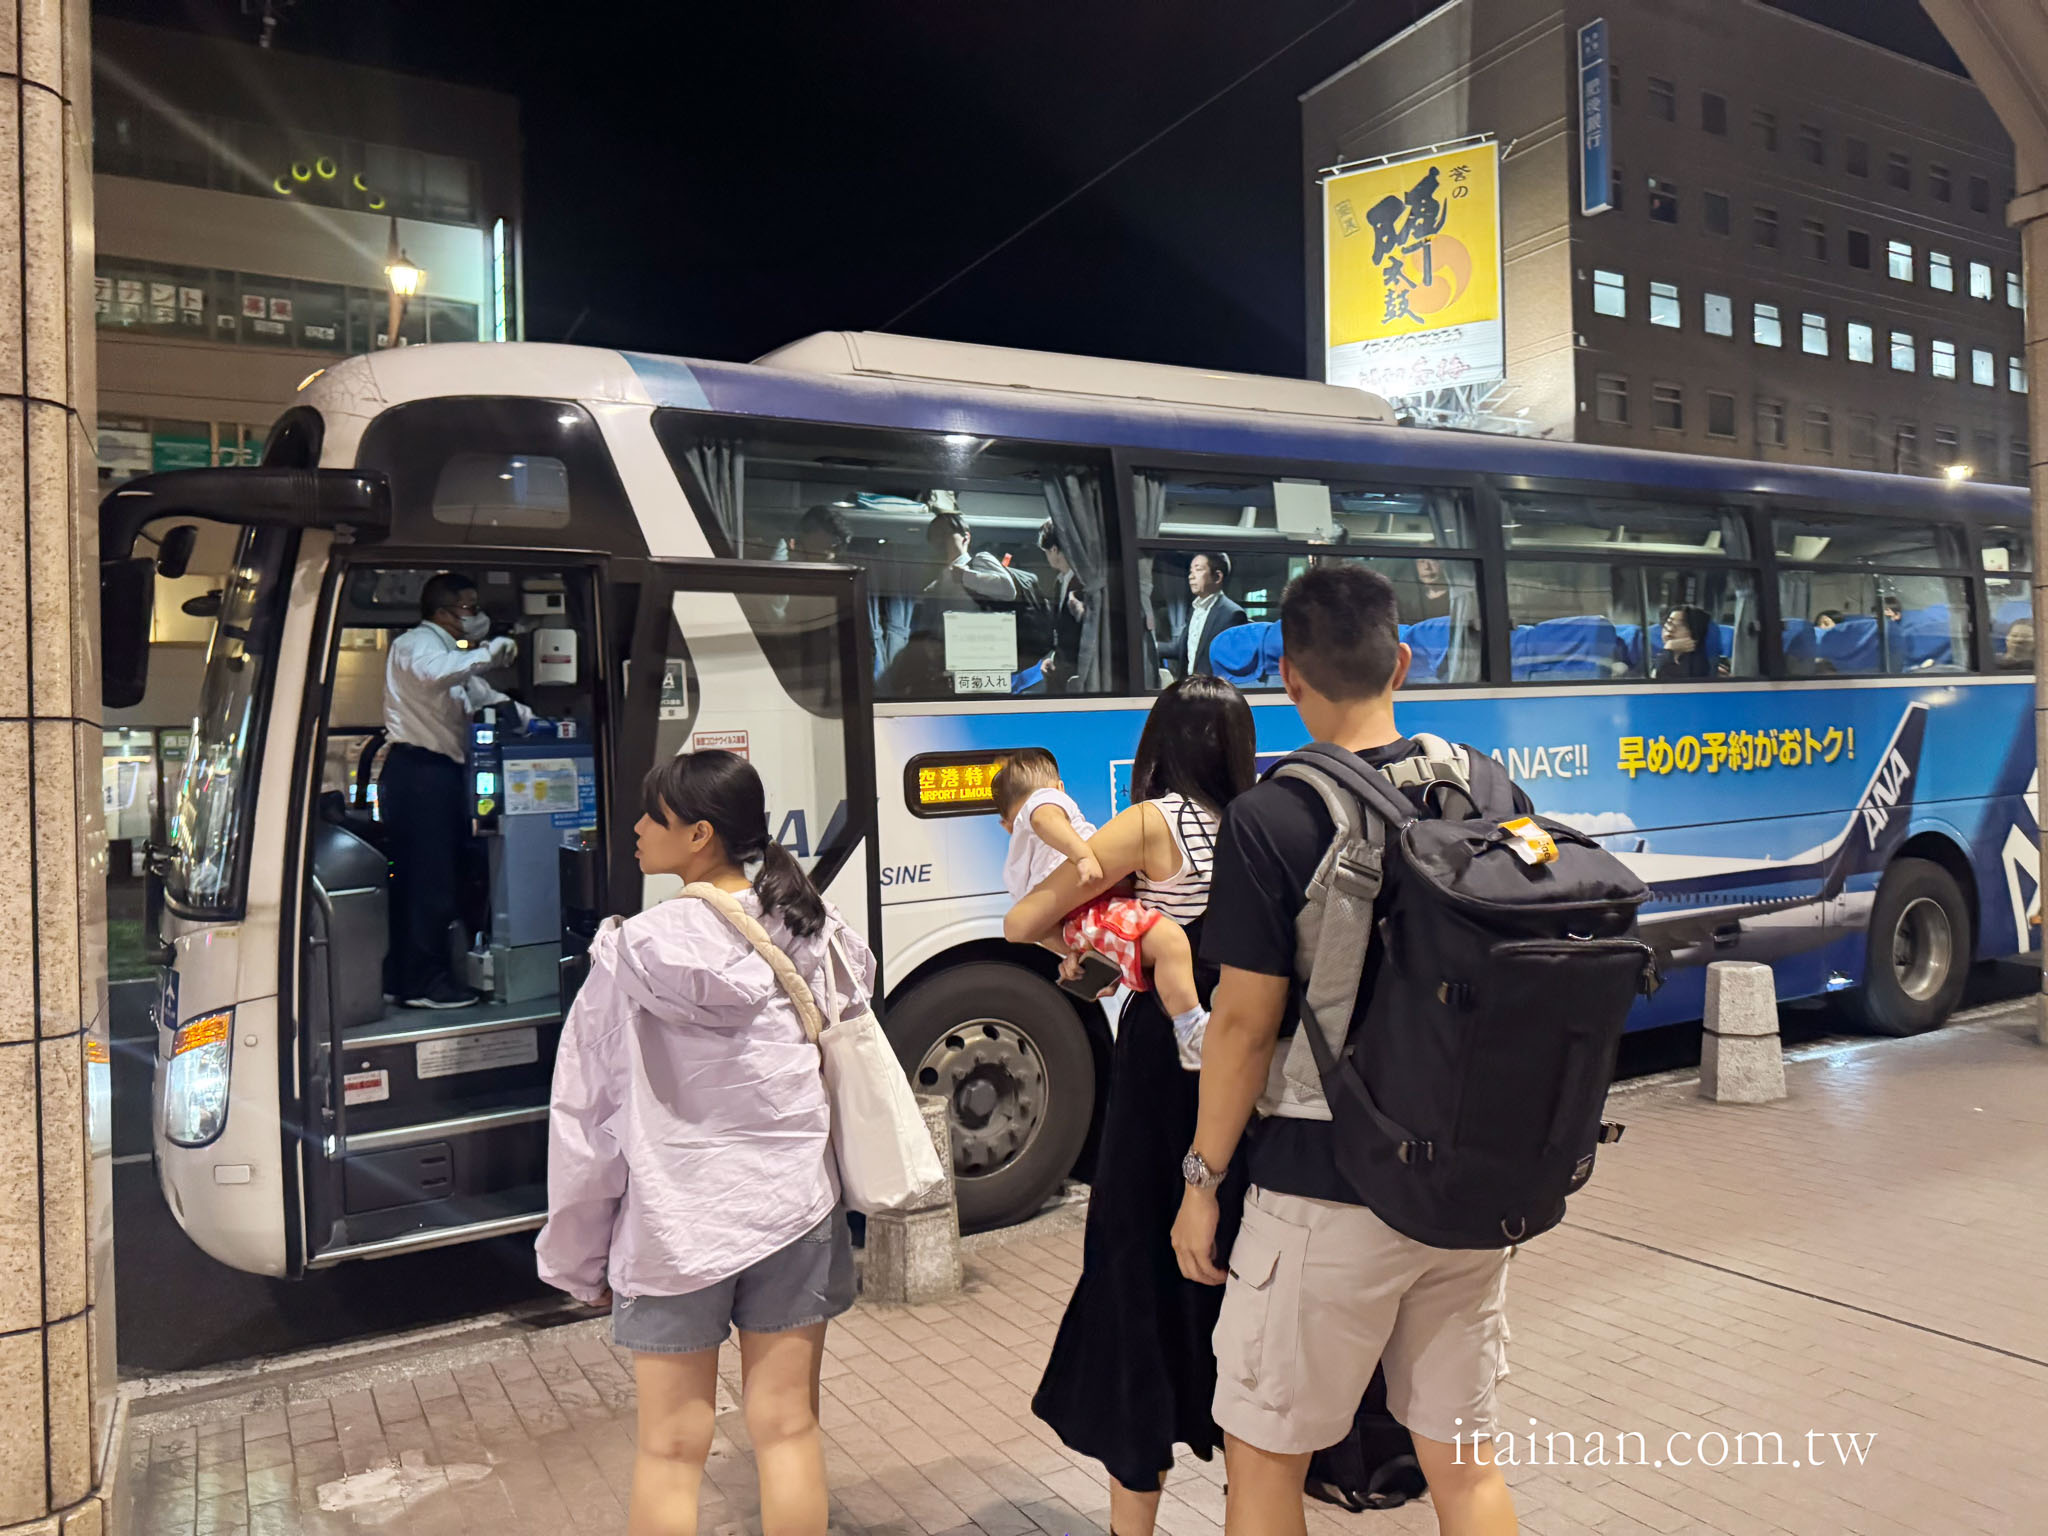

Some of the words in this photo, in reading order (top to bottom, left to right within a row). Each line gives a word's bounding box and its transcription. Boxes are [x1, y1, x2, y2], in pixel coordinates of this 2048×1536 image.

[1449, 165, 1472, 199] 誉の
[1616, 726, 1855, 779] 早めの予約がおトク!
[1863, 748, 1911, 851] ANA
